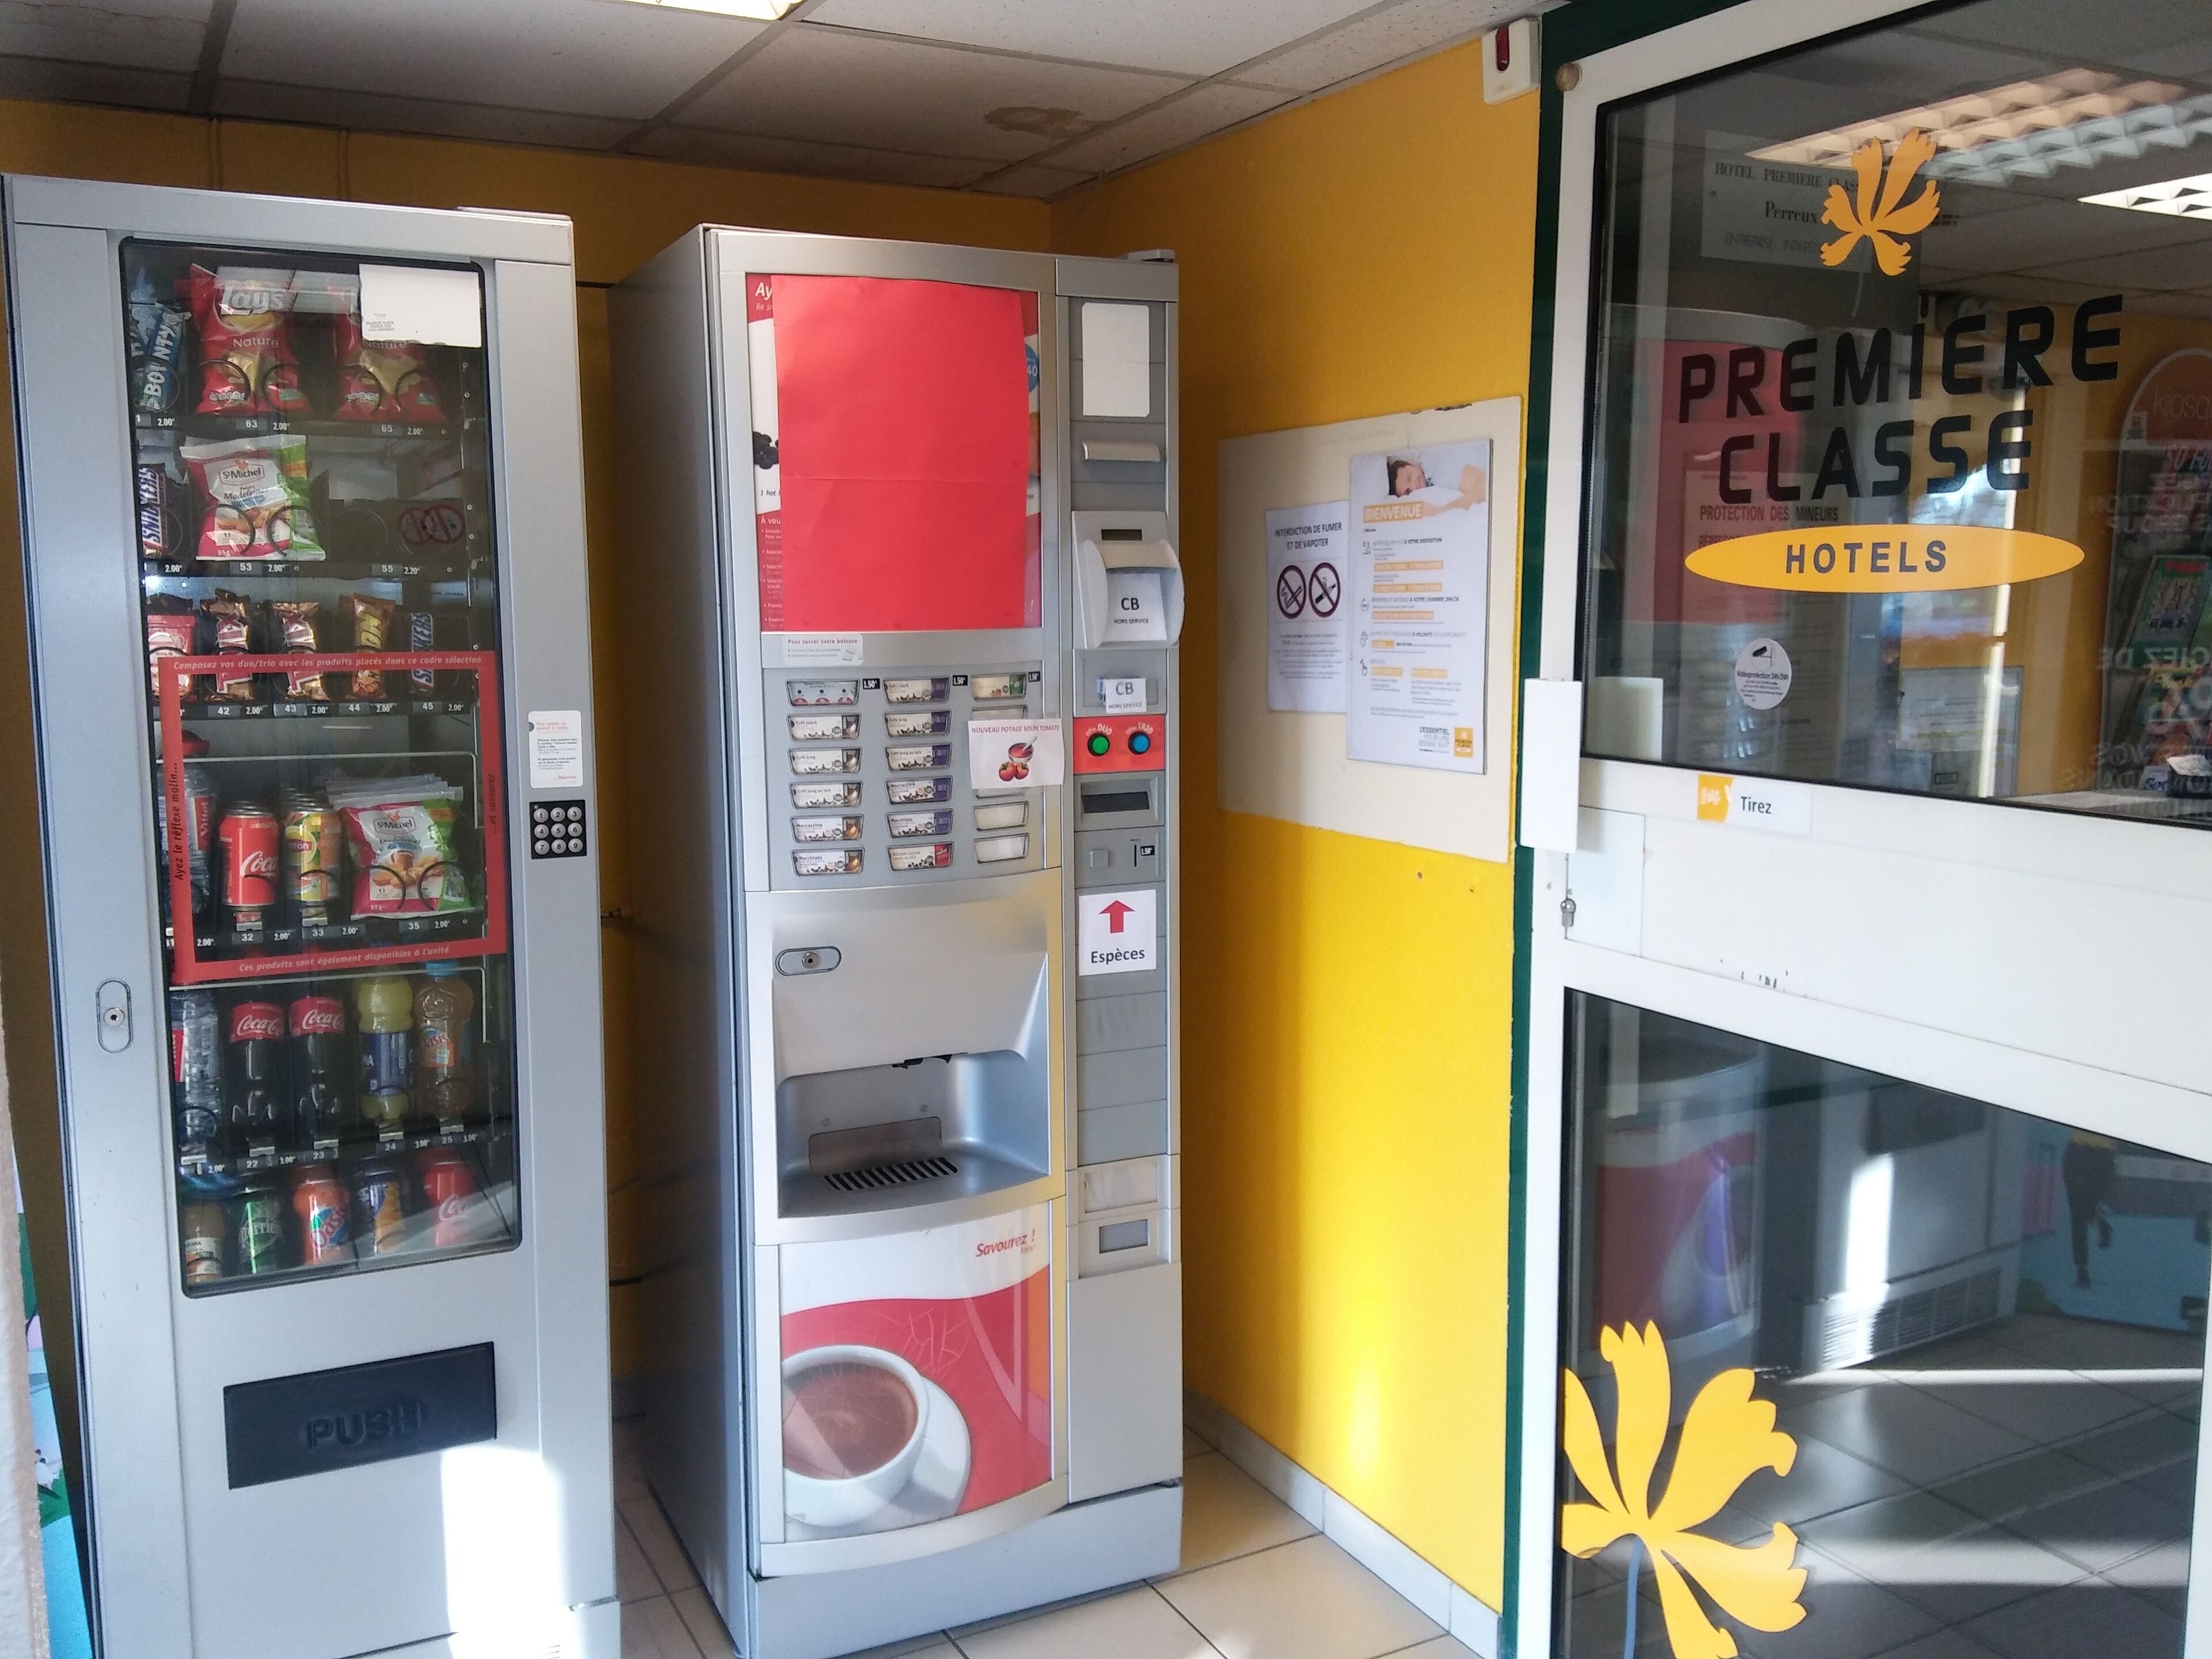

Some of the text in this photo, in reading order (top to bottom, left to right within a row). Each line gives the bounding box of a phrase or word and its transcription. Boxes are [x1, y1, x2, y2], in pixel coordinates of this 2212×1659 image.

[1715, 162, 1755, 179] HOTEL
[756, 302, 764, 310] Be
[233, 337, 279, 349] Nature
[1679, 294, 2123, 423] PREMIERE
[245, 419, 257, 429] 63
[381, 424, 393, 433] 65
[1719, 410, 2034, 504] CLASSE
[1699, 505, 1839, 522] PROTECTION DES MINEURS
[760, 516, 766, 524] À
[1275, 522, 1342, 537] INTERDICTION DE FUMER
[1287, 537, 1329, 551] ET DE VAPOTER
[1785, 541, 1946, 574] HOTELS
[240, 563, 252, 571] 53
[1121, 597, 1139, 611] CB
[173, 661, 217, 670] Composez
[238, 659, 276, 669] duo/trio
[317, 657, 353, 667] produits
[385, 657, 404, 665] dans
[420, 656, 443, 664] cadre
[445, 656, 482, 664] sélection
[1115, 681, 1134, 696] CB
[217, 707, 230, 715] 42
[285, 704, 297, 713] 43
[349, 704, 361, 712] 44
[422, 702, 434, 710] 45
[1097, 723, 1113, 736] DUO
[1138, 722, 1154, 734] TRIO
[1741, 796, 1771, 814] Tirez
[171, 806, 183, 842] réflexe
[173, 845, 183, 854] le
[175, 858, 187, 881] Ayez
[408, 922, 420, 930] 35
[241, 933, 254, 941] 32
[312, 928, 324, 937] 33
[239, 964, 253, 972] Ces
[256, 961, 292, 972] produits
[296, 958, 314, 967] sont
[317, 954, 362, 967] également
[365, 950, 411, 963] disponibles
[414, 949, 420, 957] à
[1091, 948, 1145, 965] Espèces
[385, 1143, 396, 1152] 24
[313, 1151, 324, 1160] 23
[246, 1159, 259, 1168] 22
[976, 1234, 1028, 1257] Savourez
[306, 1402, 422, 1450] PUSH
